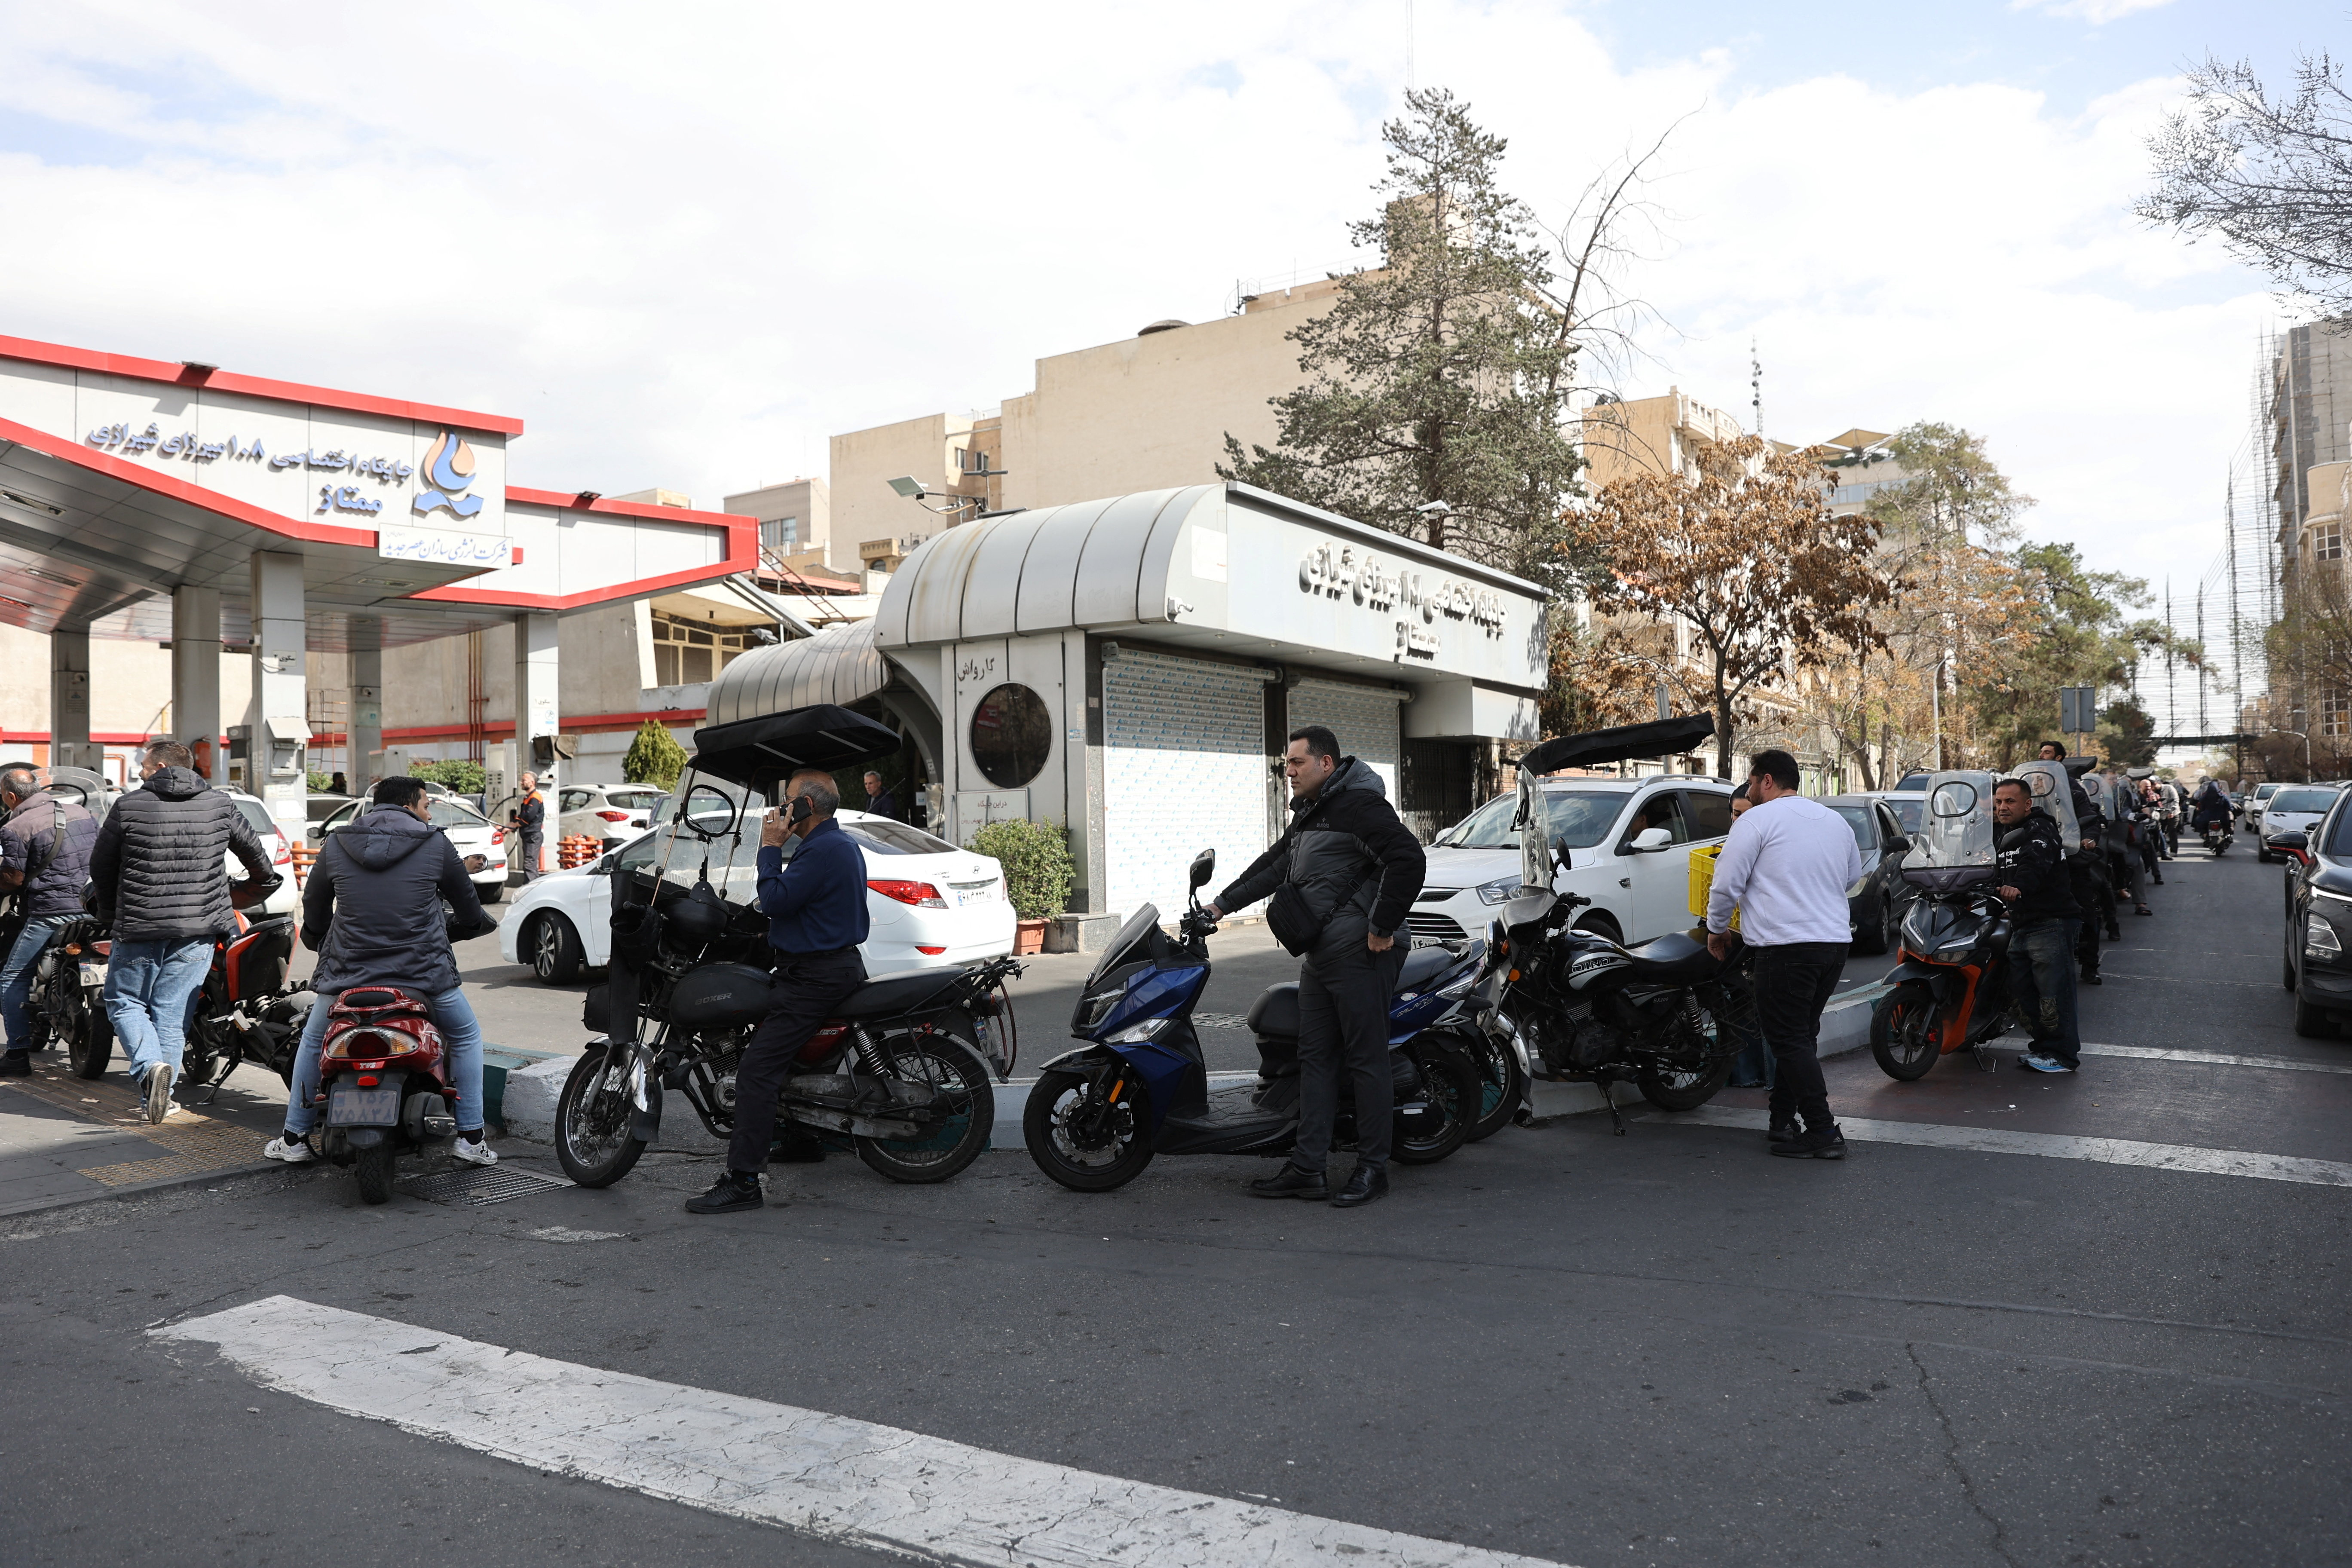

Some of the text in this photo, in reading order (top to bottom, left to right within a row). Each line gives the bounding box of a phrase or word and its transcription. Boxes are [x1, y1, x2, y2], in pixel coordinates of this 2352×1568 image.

[89, 422, 160, 450] شیرازی
[272, 447, 358, 469] اختصاصی
[359, 456, 414, 481] جایگاه
[317, 484, 383, 513] ممتاز
[384, 543, 406, 556] جدید
[418, 538, 449, 558] سازان
[448, 538, 476, 560] انرژی
[474, 538, 508, 564] شرکت
[1571, 957, 1611, 973] DINO
[695, 992, 732, 1005] BOXER
